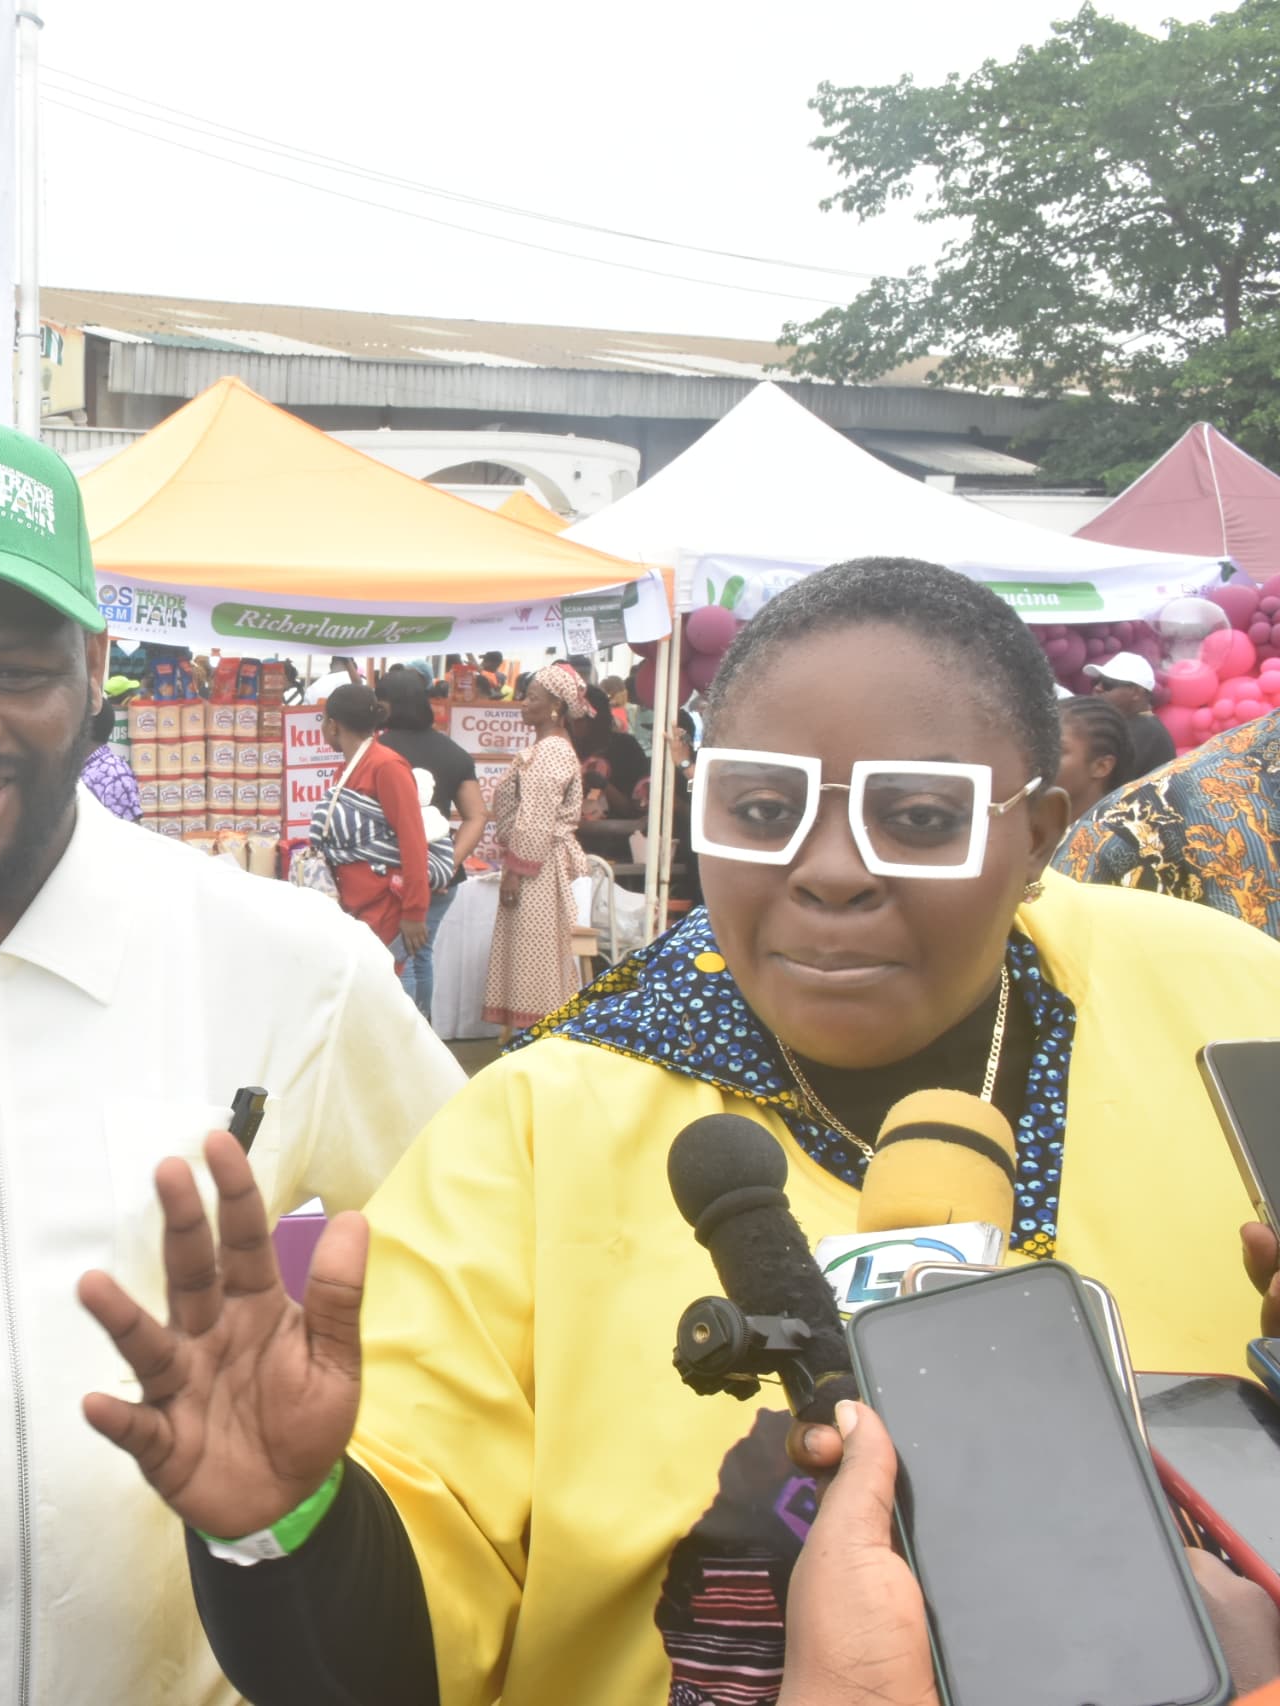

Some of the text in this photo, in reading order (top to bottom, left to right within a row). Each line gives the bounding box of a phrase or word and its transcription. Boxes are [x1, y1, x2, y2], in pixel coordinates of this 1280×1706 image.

[135, 591, 186, 609] TRADE
[996, 588, 1060, 606] ucina
[234, 609, 375, 640] Richerland
[462, 715, 535, 733] Cocon
[478, 732, 530, 748] Garri
